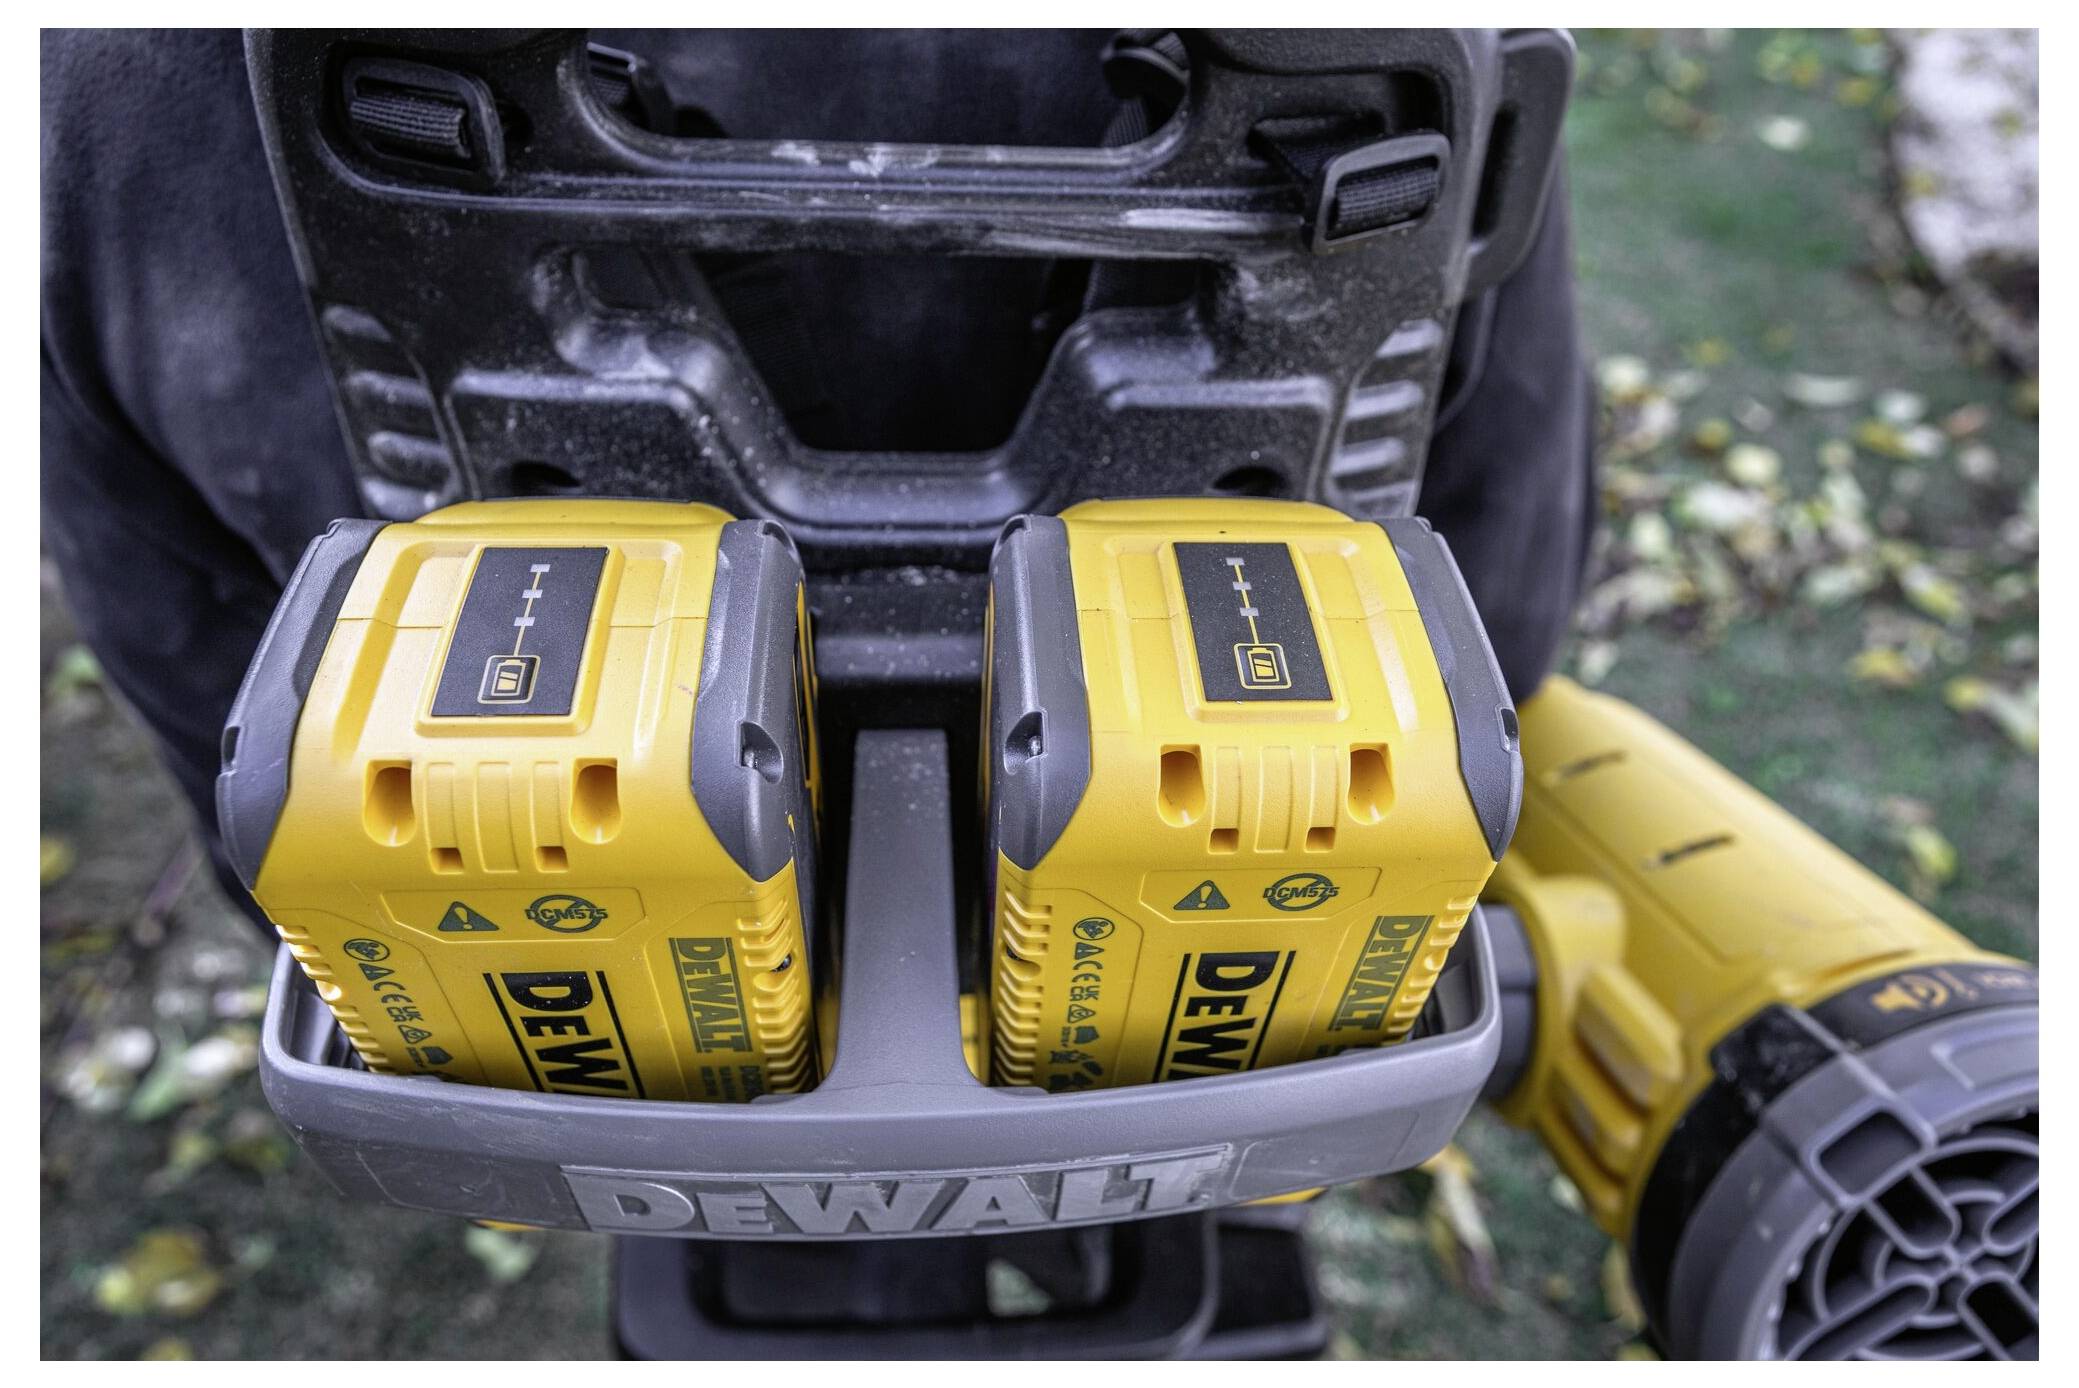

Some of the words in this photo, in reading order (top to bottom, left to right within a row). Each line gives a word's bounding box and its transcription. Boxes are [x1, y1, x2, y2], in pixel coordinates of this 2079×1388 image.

[523, 907, 609, 921] DCM575
[1262, 886, 1341, 899] DCM575
[675, 937, 748, 1053] DEWALT
[1338, 915, 1430, 1030] DEWALT
[500, 971, 632, 1096] DEW
[562, 1152, 1223, 1235] DEWALT
